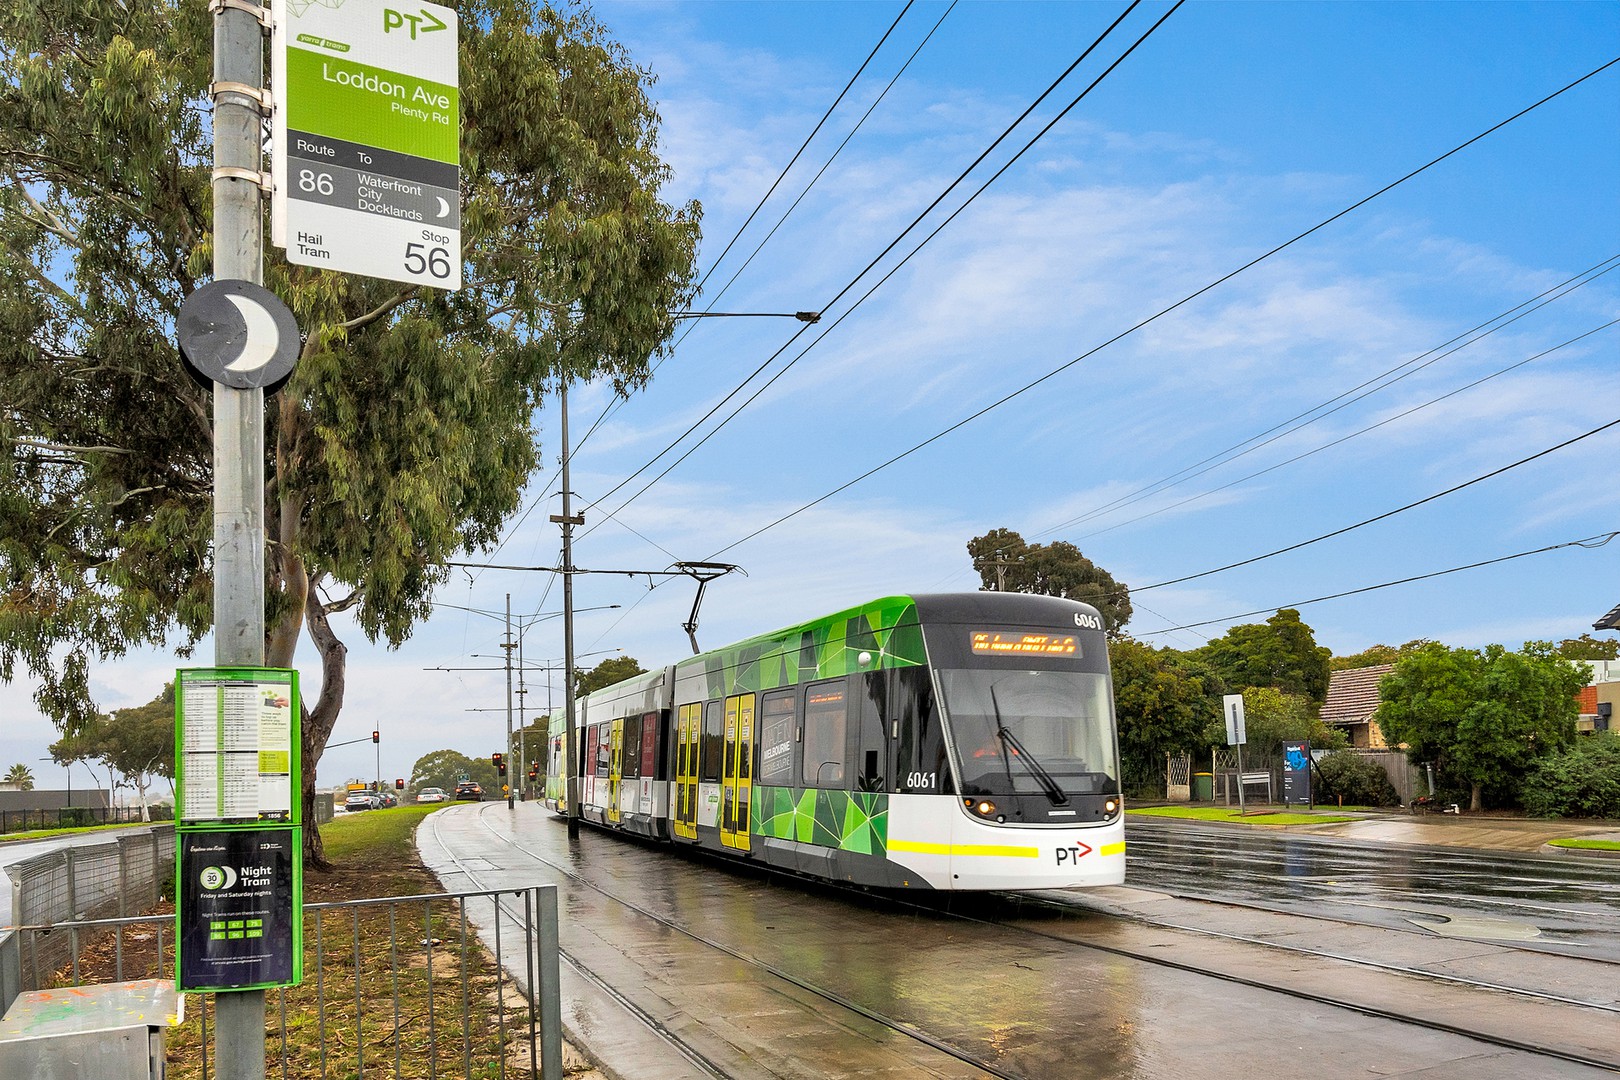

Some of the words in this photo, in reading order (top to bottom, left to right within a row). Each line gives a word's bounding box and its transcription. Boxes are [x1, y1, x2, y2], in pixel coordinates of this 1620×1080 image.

[300, 34, 320, 46] yarra
[325, 40, 347, 52] trams
[322, 62, 406, 99] Loddon
[412, 85, 450, 109] Ave
[391, 102, 429, 122] Plenty
[432, 111, 449, 125] Rd
[297, 139, 335, 157] Route
[357, 151, 373, 165] To
[298, 169, 334, 196] 86
[357, 173, 422, 196] Waterfront
[357, 187, 383, 202] City
[357, 198, 423, 221] Docklands
[297, 231, 323, 246] Hail
[421, 229, 450, 246] Stop
[297, 243, 330, 259] Tram
[403, 242, 451, 279] 56
[1074, 612, 1102, 630] 6061
[907, 771, 936, 789] 6061
[206, 874, 217, 882] 30
[241, 866, 272, 877] Night
[241, 877, 270, 886] Tram
[228, 890, 254, 899] Saturday
[254, 889, 272, 897] nights
